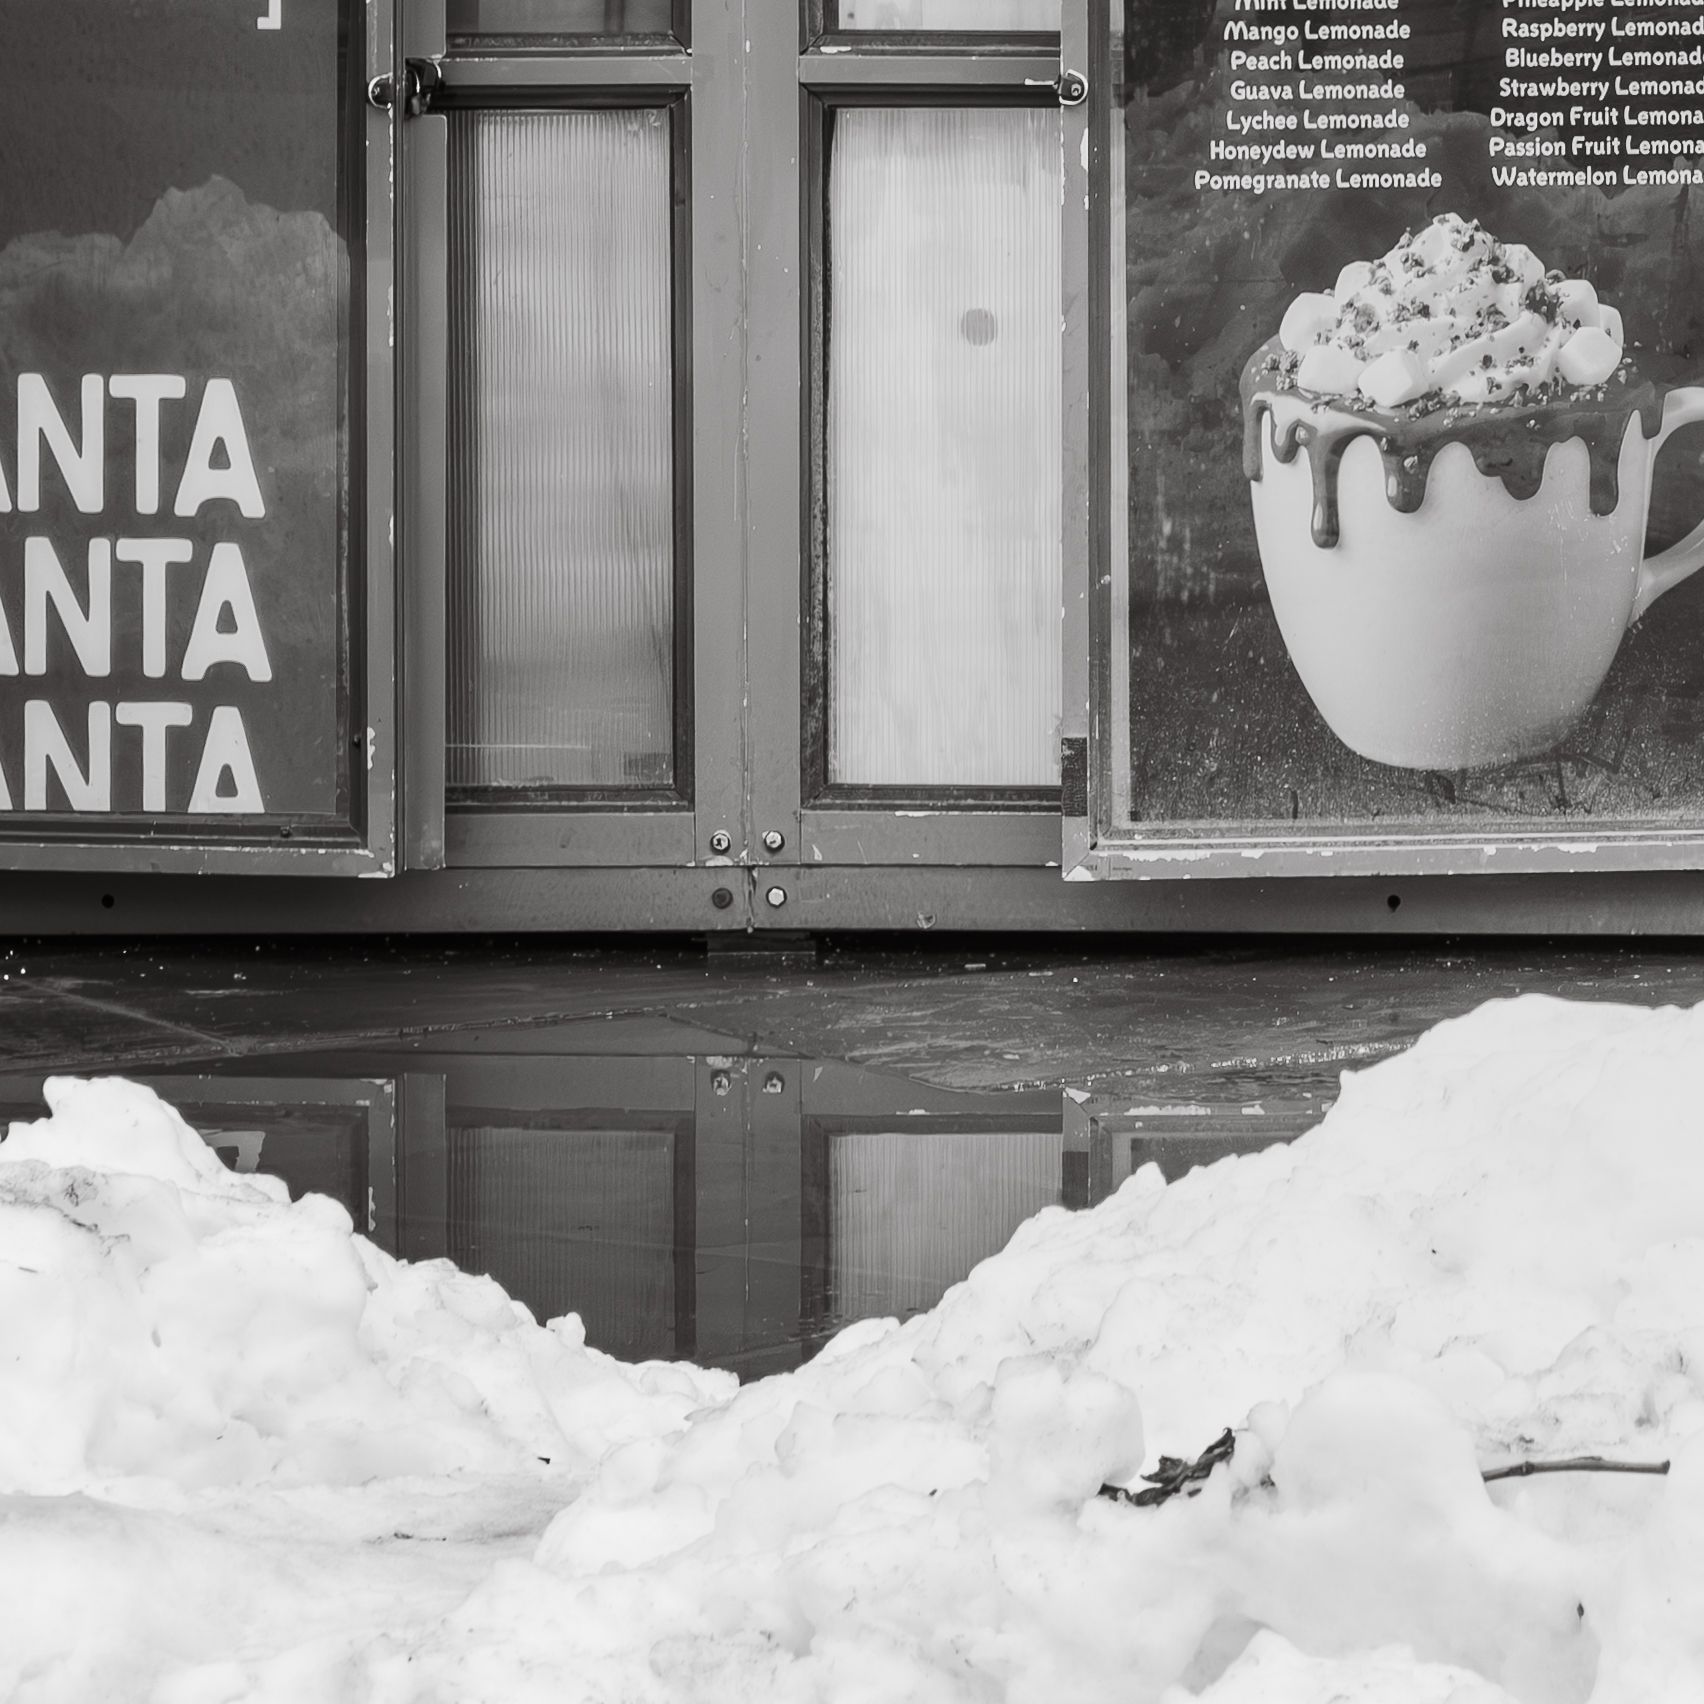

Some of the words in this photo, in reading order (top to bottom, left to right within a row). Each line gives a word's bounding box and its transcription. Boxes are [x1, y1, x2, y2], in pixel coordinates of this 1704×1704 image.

[1490, 107, 1564, 132] Dragon
[1569, 105, 1619, 126] Fruit
[1194, 170, 1331, 195] Pomegranate
[1335, 167, 1443, 189] Lemonade
[0, 372, 266, 518] NTA
[0, 536, 272, 682] NTA
[0, 699, 265, 813] NTA
